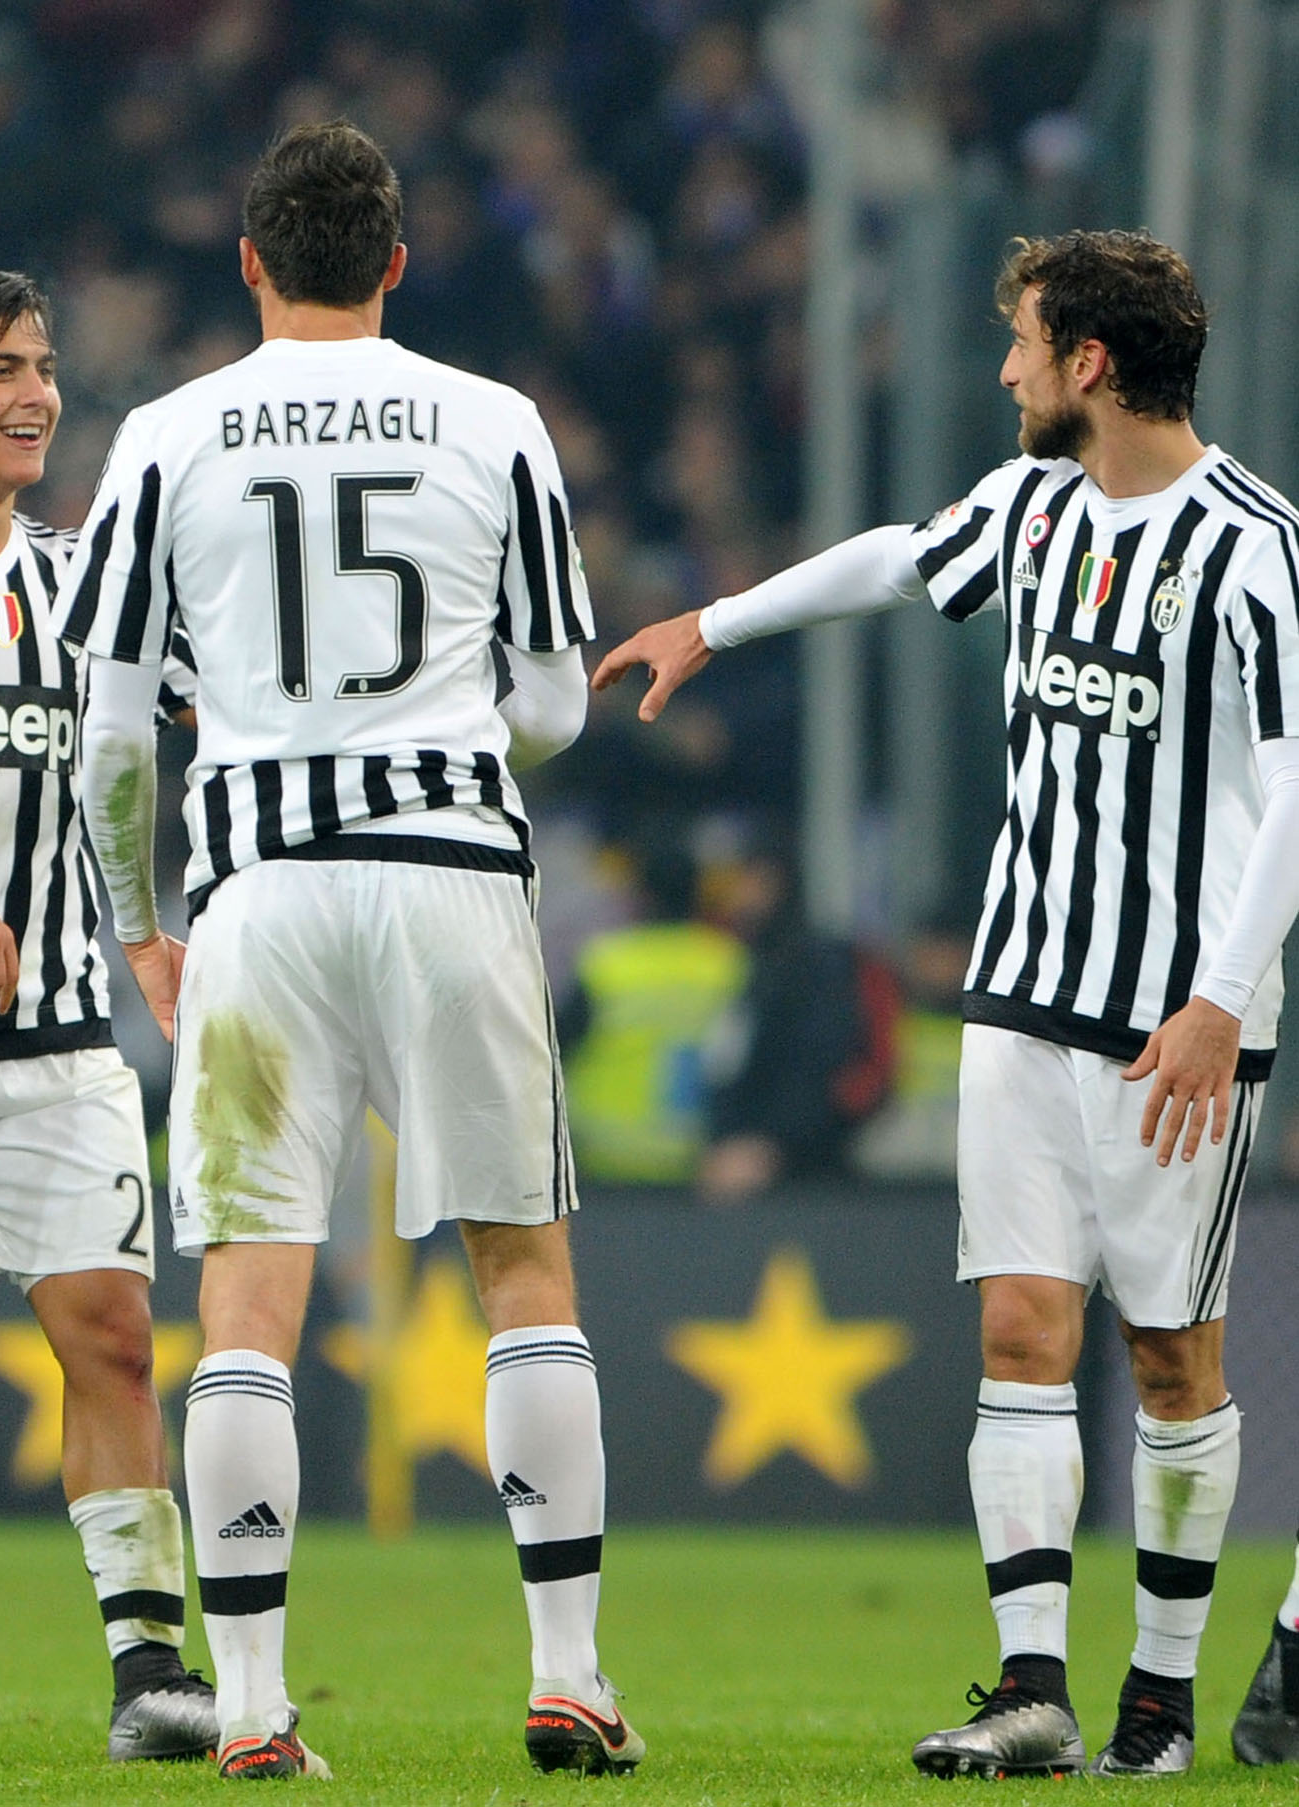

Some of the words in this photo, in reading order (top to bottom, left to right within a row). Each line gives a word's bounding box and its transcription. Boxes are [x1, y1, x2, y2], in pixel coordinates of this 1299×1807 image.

[221, 399, 439, 451] BARZAGLI
[242, 471, 430, 702] 15
[1019, 630, 1161, 737] Jeep
[218, 1525, 286, 1539] adidas
